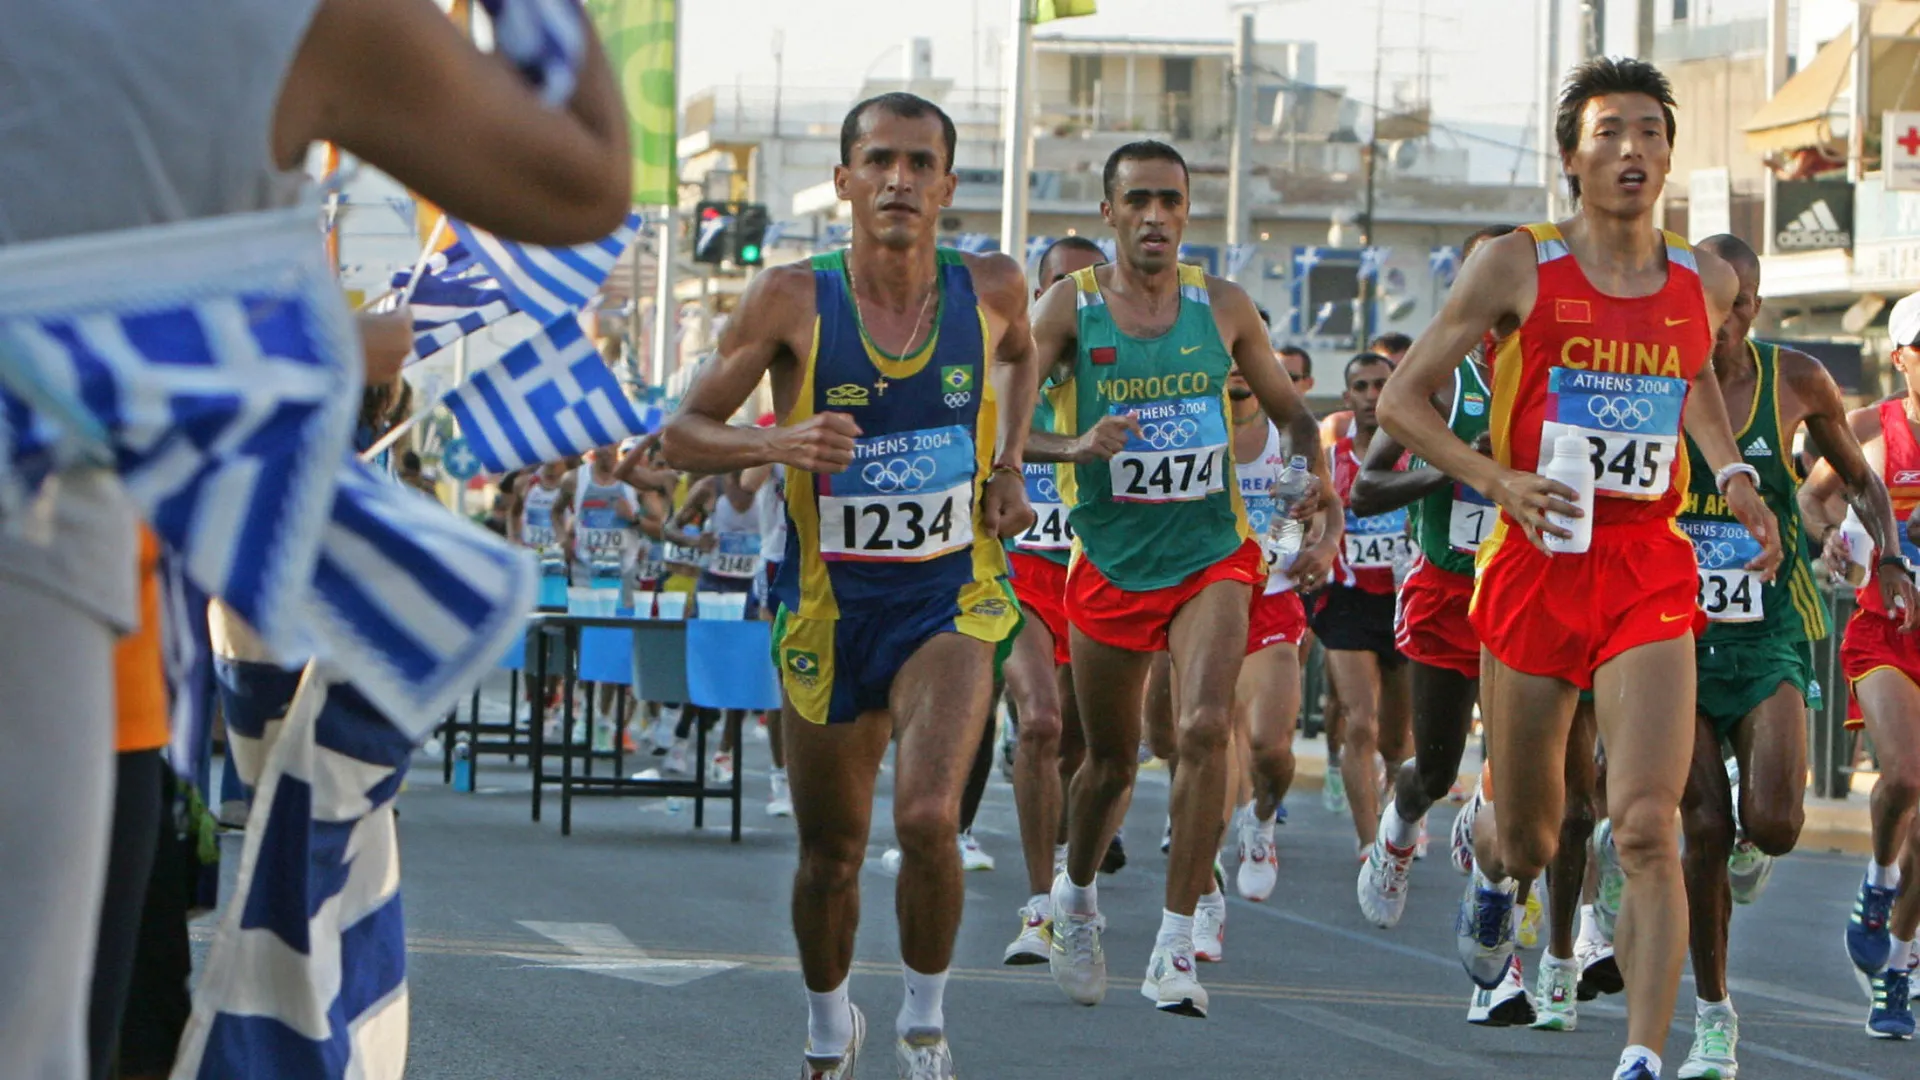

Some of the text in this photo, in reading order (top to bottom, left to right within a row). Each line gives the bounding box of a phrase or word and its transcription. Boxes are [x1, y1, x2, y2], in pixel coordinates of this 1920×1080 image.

[1777, 230, 1851, 250] adidas
[1561, 336, 1682, 379] CHINA
[1096, 372, 1209, 402] MOROCCO
[1573, 373, 1671, 395] ATHENS 2004
[1178, 402, 1207, 415] 2004
[912, 432, 952, 452] 2004
[1122, 452, 1215, 495] 2474
[1238, 477, 1275, 491] REA
[843, 497, 953, 550] 1234
[1719, 526, 1751, 540] 2004
